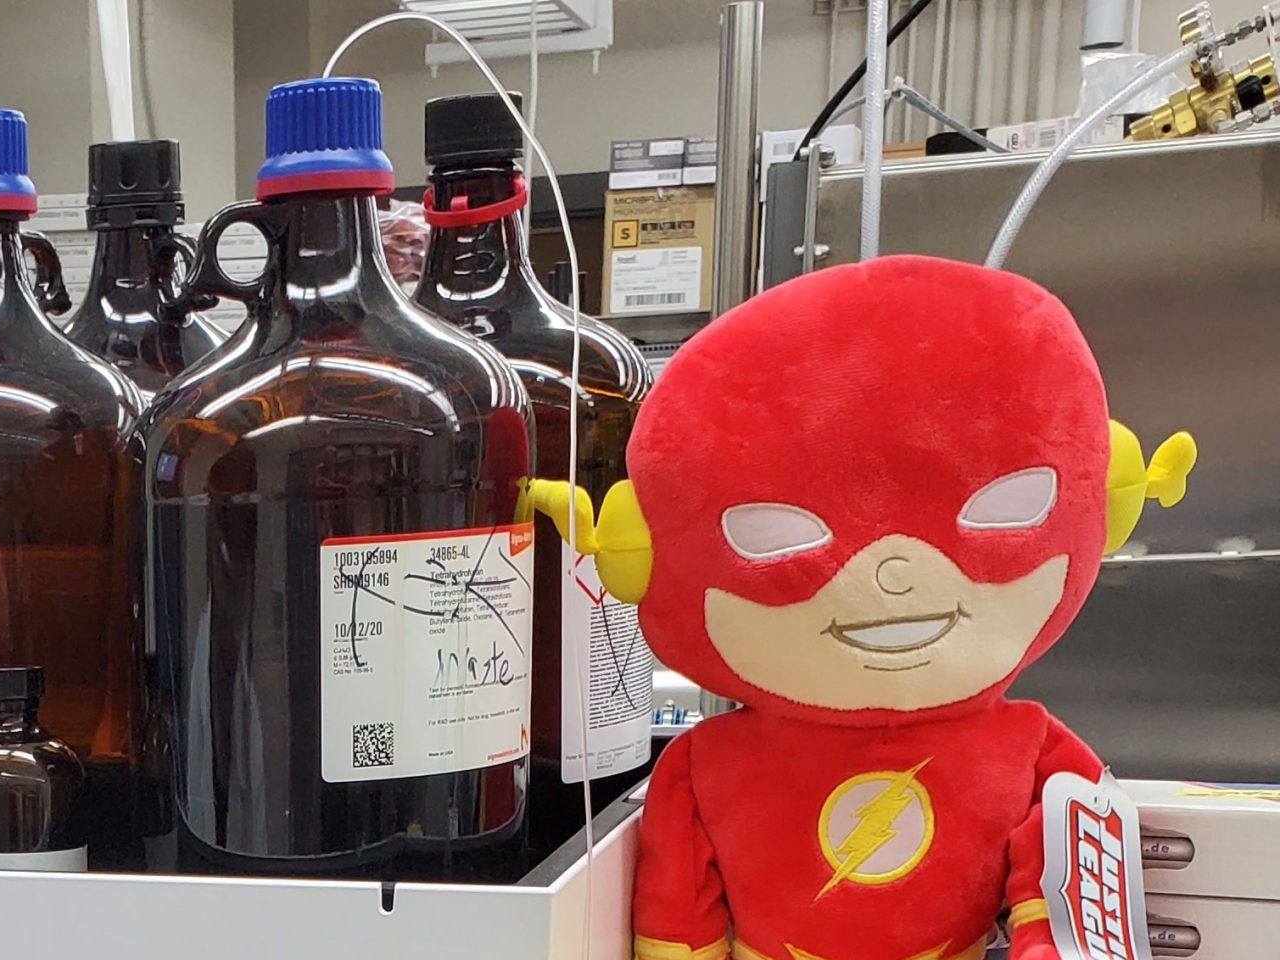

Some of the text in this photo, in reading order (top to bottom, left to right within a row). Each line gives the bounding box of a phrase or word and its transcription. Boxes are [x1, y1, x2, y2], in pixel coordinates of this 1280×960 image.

[621, 228, 631, 240] S
[430, 545, 470, 561] 34865-4L
[335, 621, 382, 637] 10/12/20
